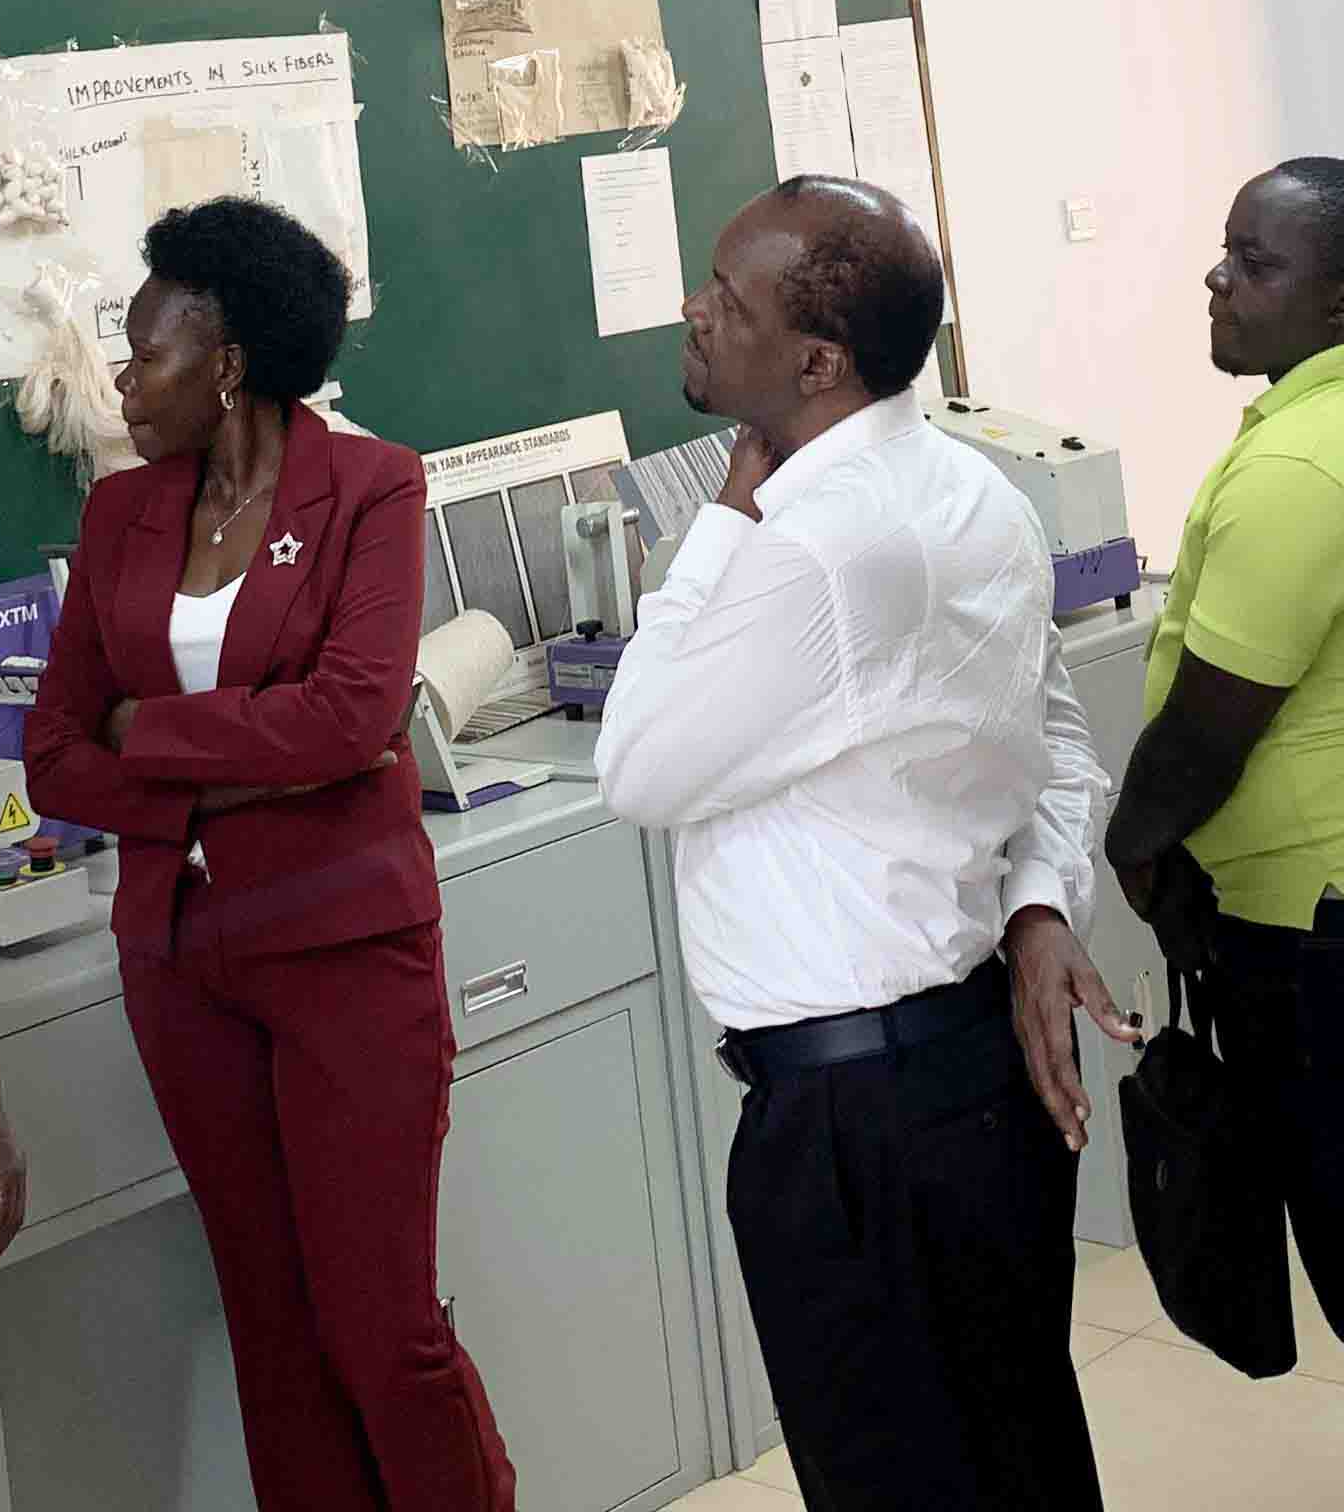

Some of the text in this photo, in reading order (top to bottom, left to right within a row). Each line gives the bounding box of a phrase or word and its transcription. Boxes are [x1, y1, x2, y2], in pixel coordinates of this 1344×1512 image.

[67, 52, 334, 106] IMPROVEMENTS IN SILK FIBERS
[439, 453, 464, 474] YARN
[465, 441, 524, 465] APPEARANCE
[523, 429, 571, 453] STANDARDS
